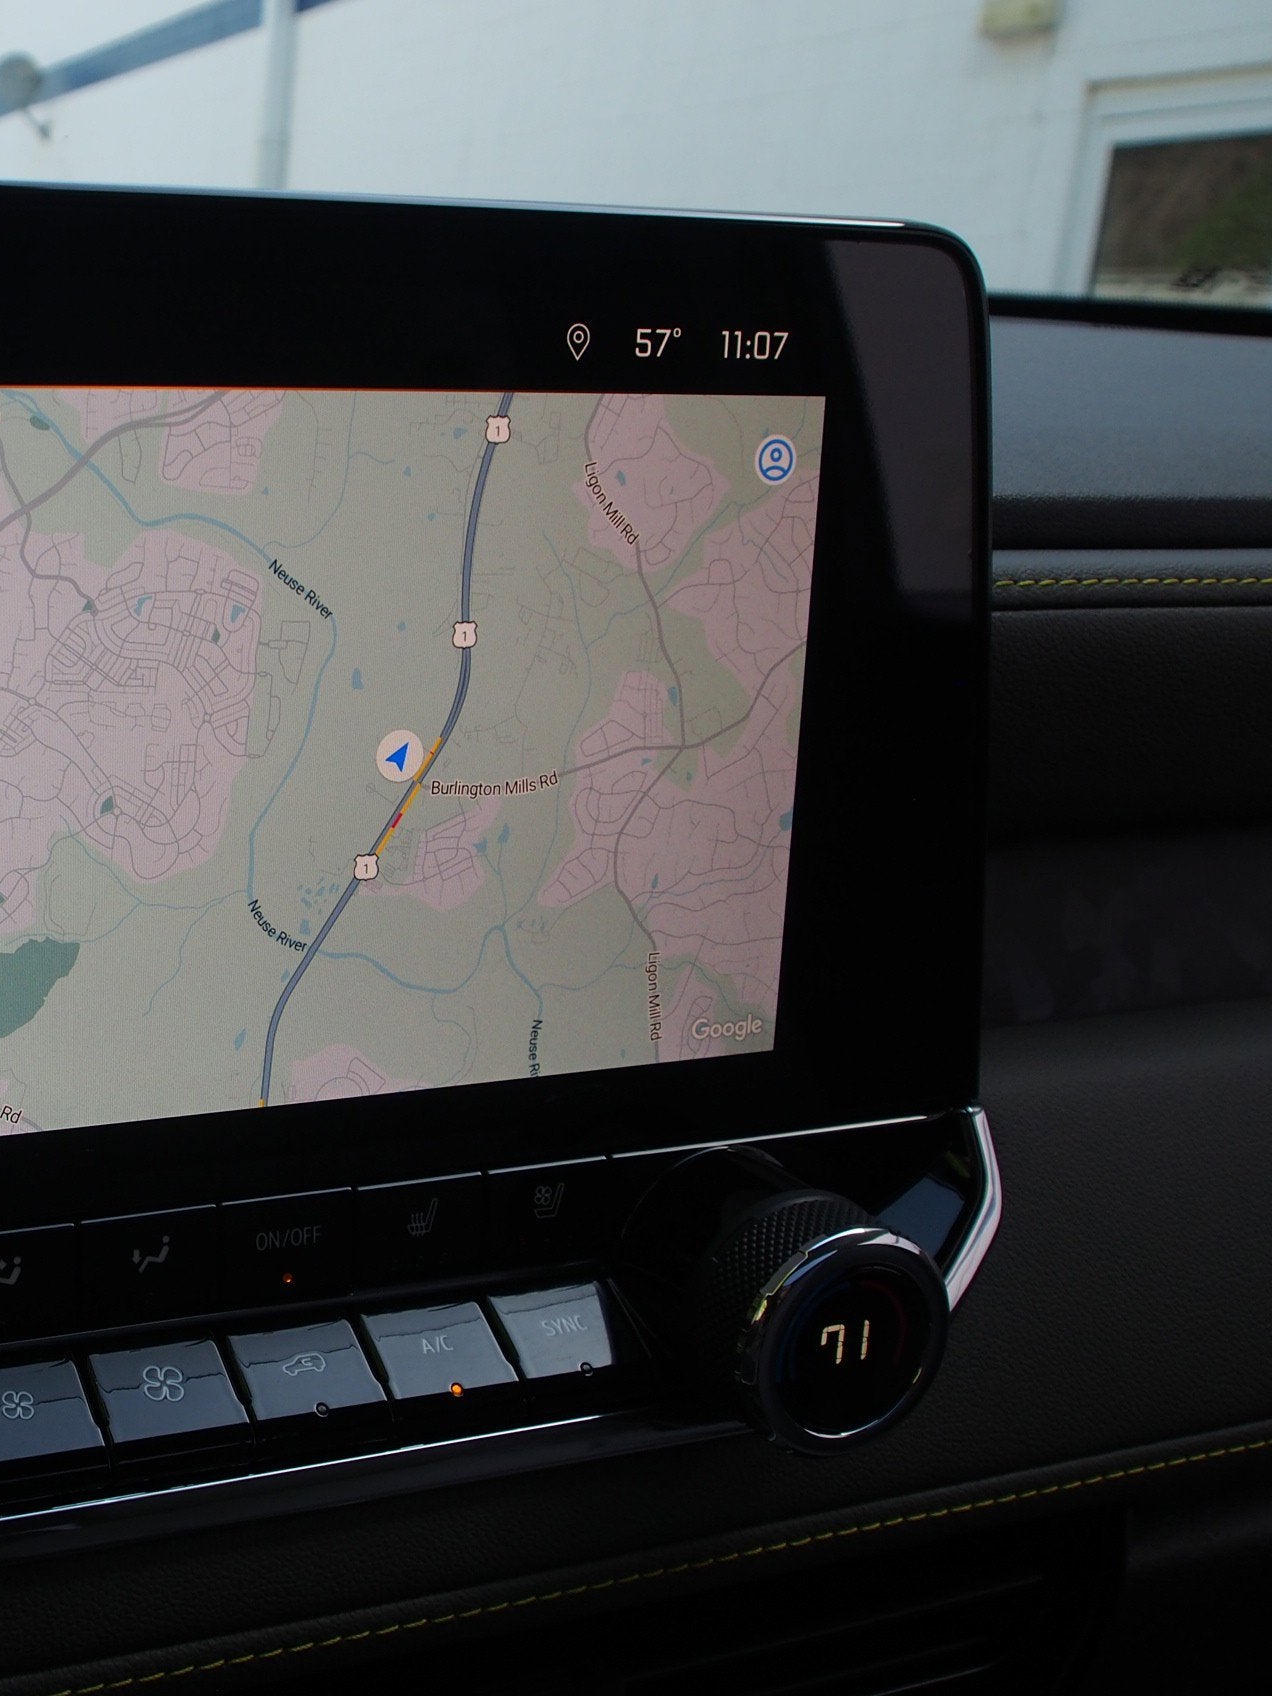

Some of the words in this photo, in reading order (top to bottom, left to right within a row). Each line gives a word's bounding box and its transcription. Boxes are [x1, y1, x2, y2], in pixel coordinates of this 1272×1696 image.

[634, 327, 682, 358] 57°
[721, 330, 789, 360] 11:07
[584, 462, 607, 505] Ligon
[602, 501, 626, 529] Mill
[620, 523, 640, 545] Rd
[268, 558, 305, 596] Neuse
[304, 589, 334, 620] River
[431, 780, 501, 799] Burlington
[505, 778, 536, 795] Mills
[539, 770, 558, 789] Rd
[248, 898, 277, 938] Neuse
[275, 930, 307, 952] River
[645, 952, 660, 991] Ligon
[648, 994, 662, 1020] Mill
[528, 1019, 543, 1060] Neuse
[650, 1022, 662, 1041] Rd
[691, 1013, 763, 1041] Google
[0, 1105, 22, 1124] Rd
[255, 1224, 322, 1251] ON/OFF
[541, 1315, 588, 1338] SYNC
[421, 1334, 454, 1355] A/C
[820, 1319, 870, 1365] 71
